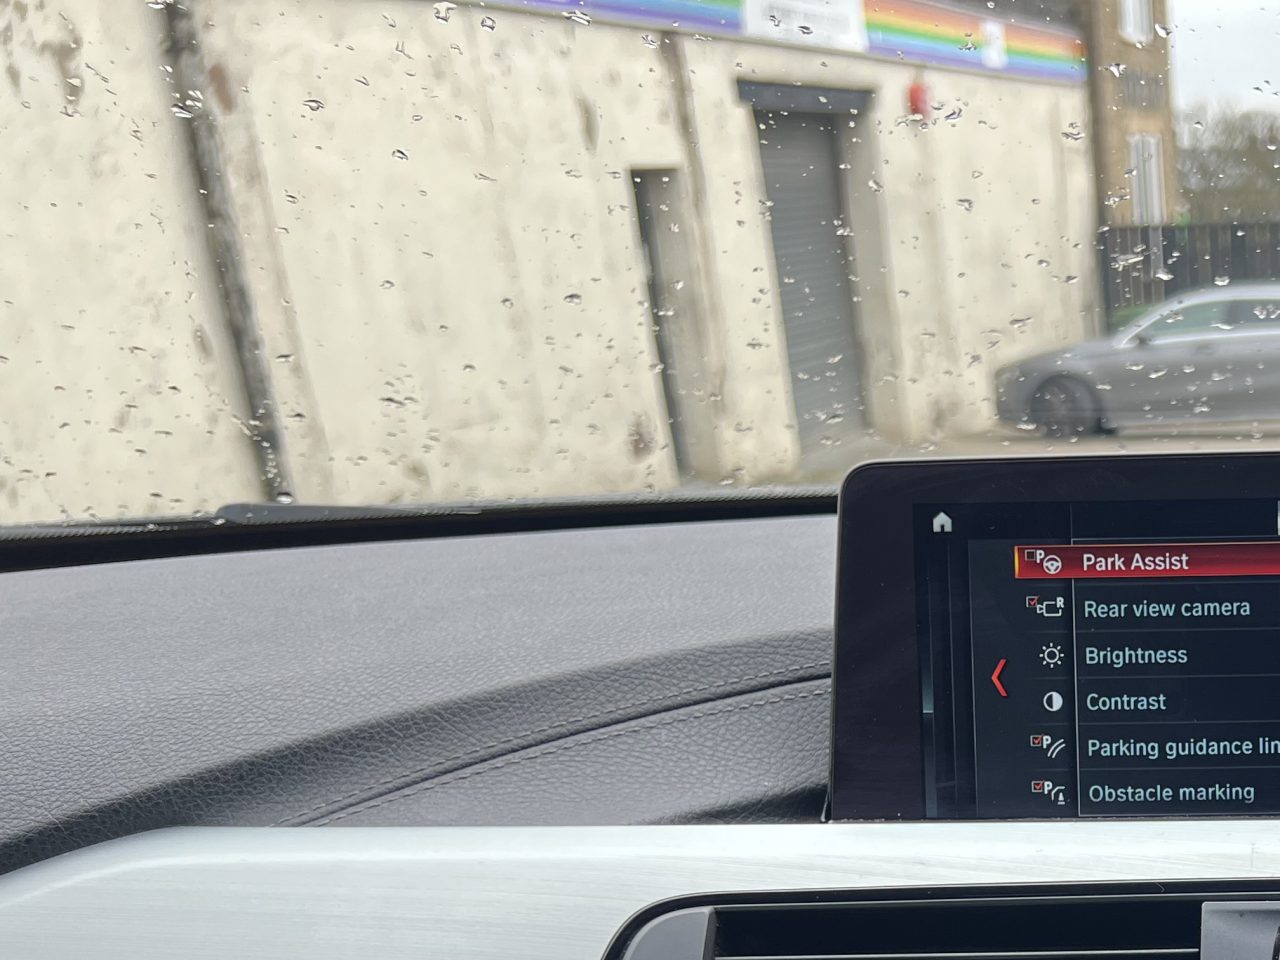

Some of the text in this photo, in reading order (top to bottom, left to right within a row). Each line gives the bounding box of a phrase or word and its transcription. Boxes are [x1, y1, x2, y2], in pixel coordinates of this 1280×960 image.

[1083, 552, 1189, 571] Park Assist
[1084, 599, 1251, 618] Rear view camera
[1085, 646, 1188, 668] Brightness
[1086, 693, 1167, 711] Contrast
[1088, 739, 1159, 760] Parking
[1165, 738, 1253, 760] guidance
[1089, 783, 1255, 804] Obstacle marking
